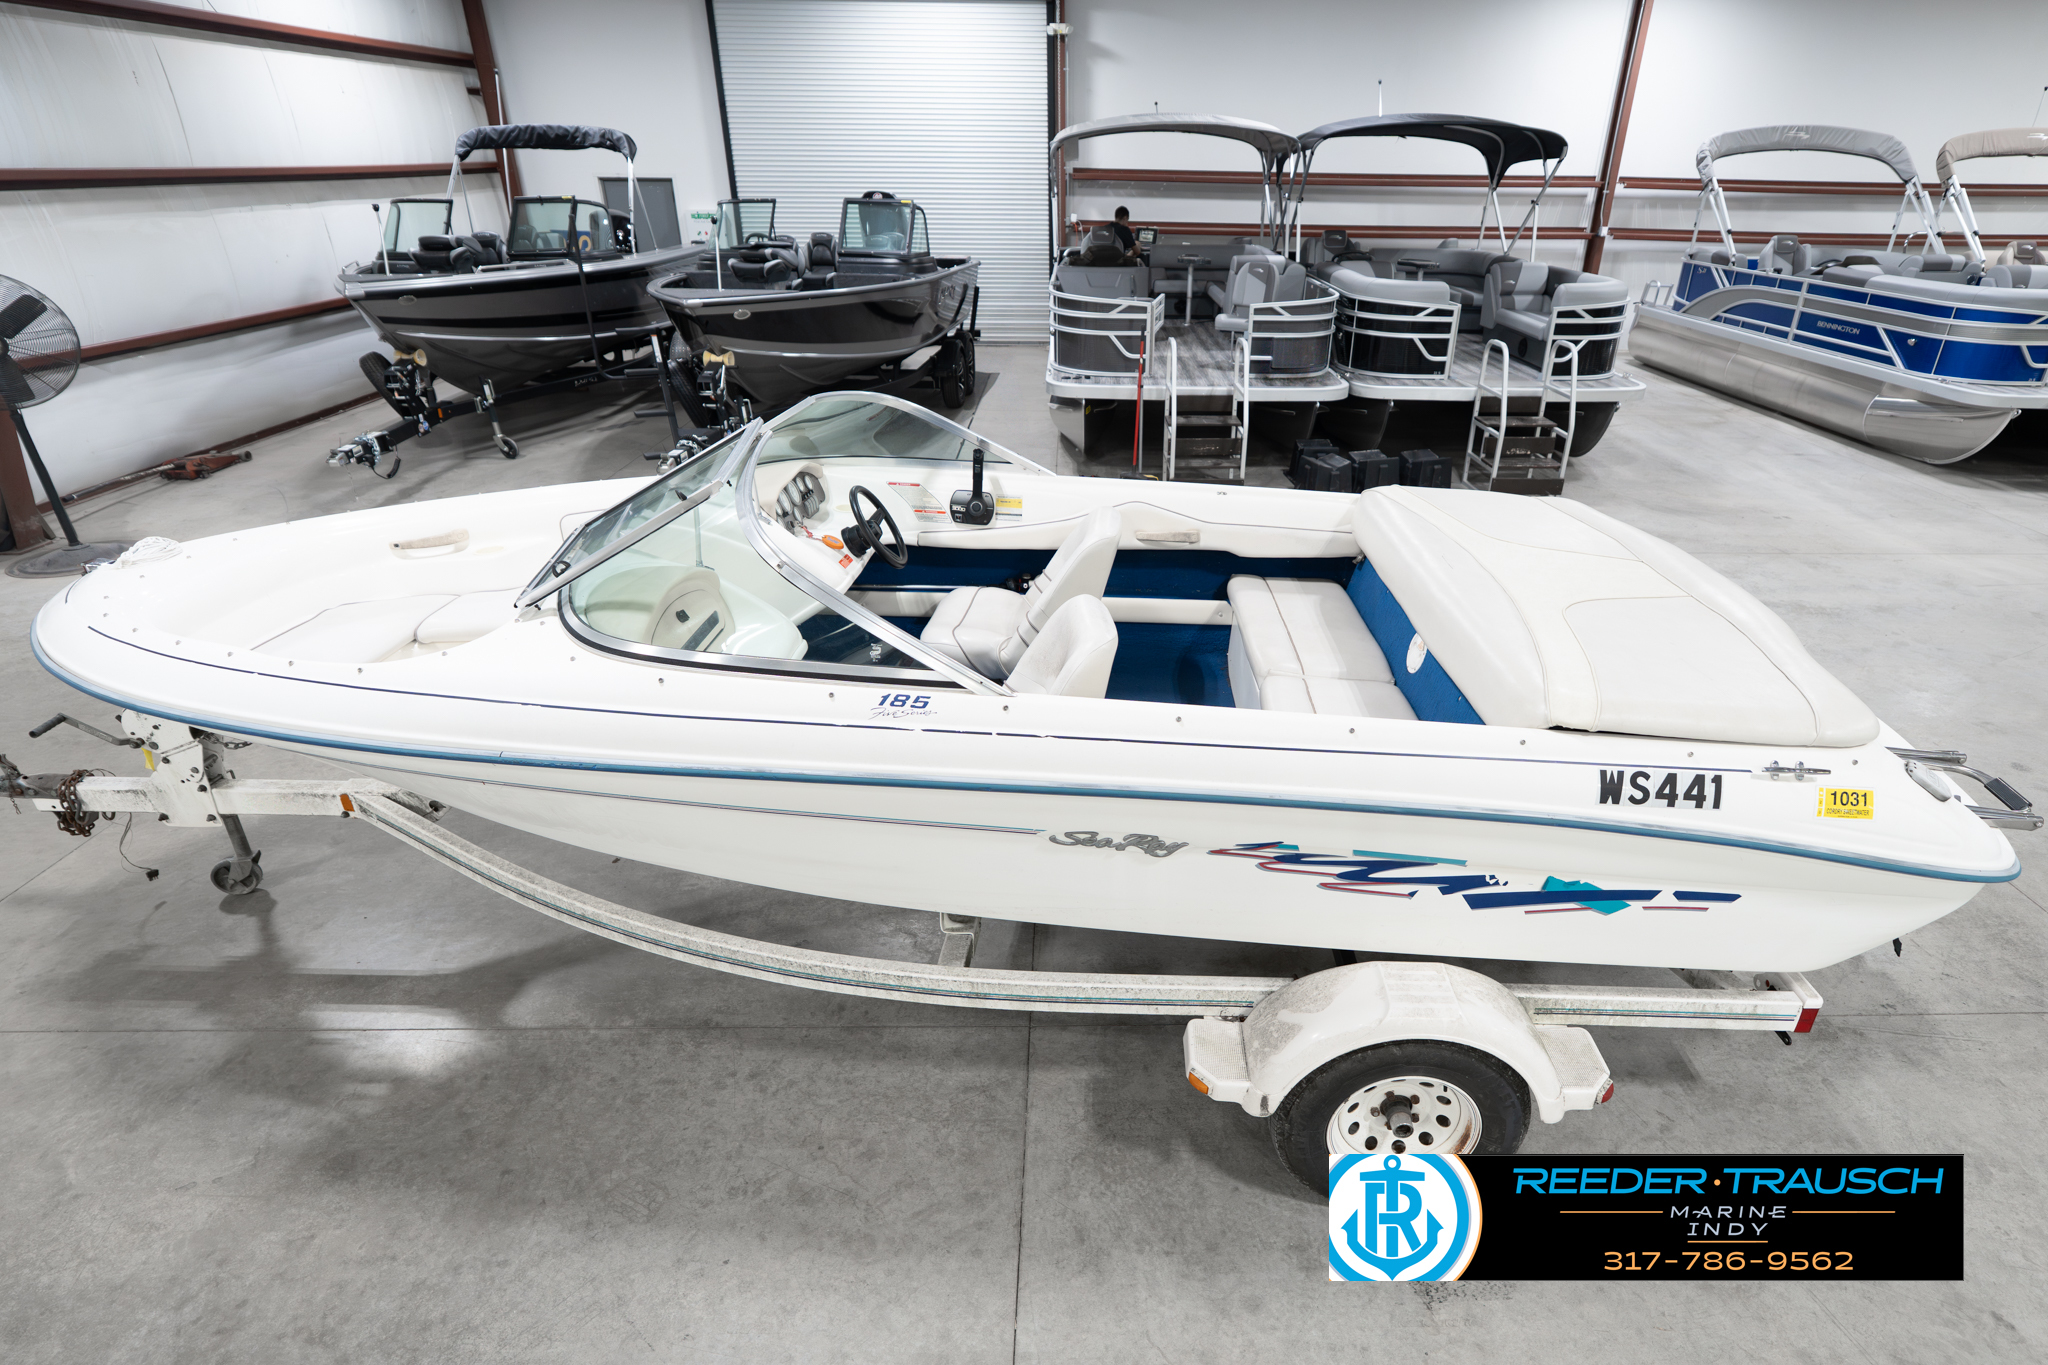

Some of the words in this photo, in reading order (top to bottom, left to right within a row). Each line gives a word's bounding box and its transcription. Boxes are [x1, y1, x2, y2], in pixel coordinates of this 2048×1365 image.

[1817, 320, 1861, 335] BENNINGTON
[878, 693, 931, 709] 185
[1599, 769, 1722, 810] WS441
[1830, 790, 1867, 807] 1031
[1049, 830, 1114, 849] Sea
[1115, 833, 1190, 858] Ray
